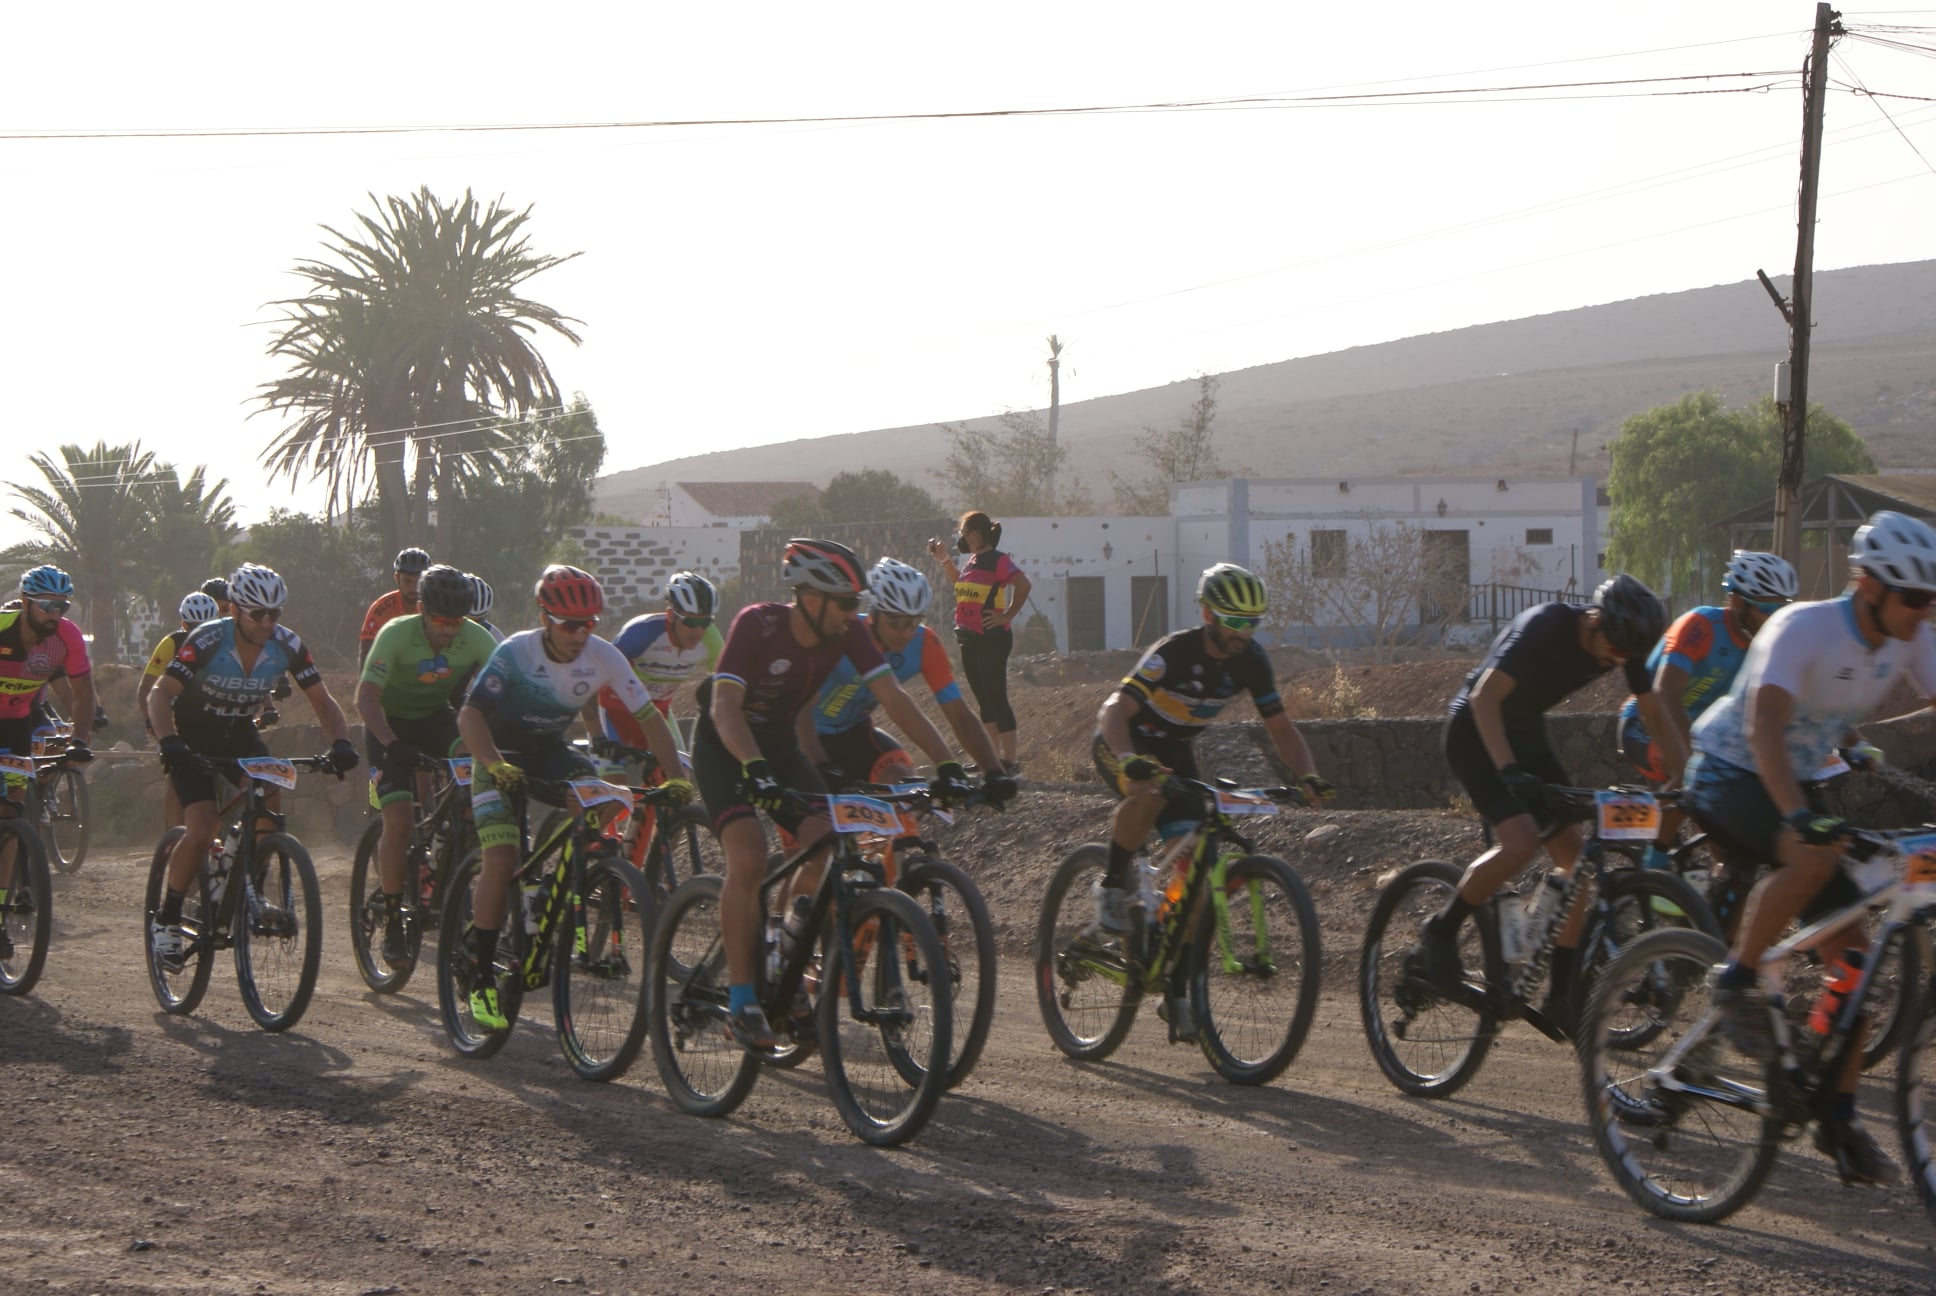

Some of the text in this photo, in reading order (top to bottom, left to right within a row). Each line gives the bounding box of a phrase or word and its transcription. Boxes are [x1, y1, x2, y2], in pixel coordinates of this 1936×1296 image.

[205, 673, 270, 690] RIBBL
[201, 682, 265, 704] WELDTI
[844, 804, 888, 824] 203
